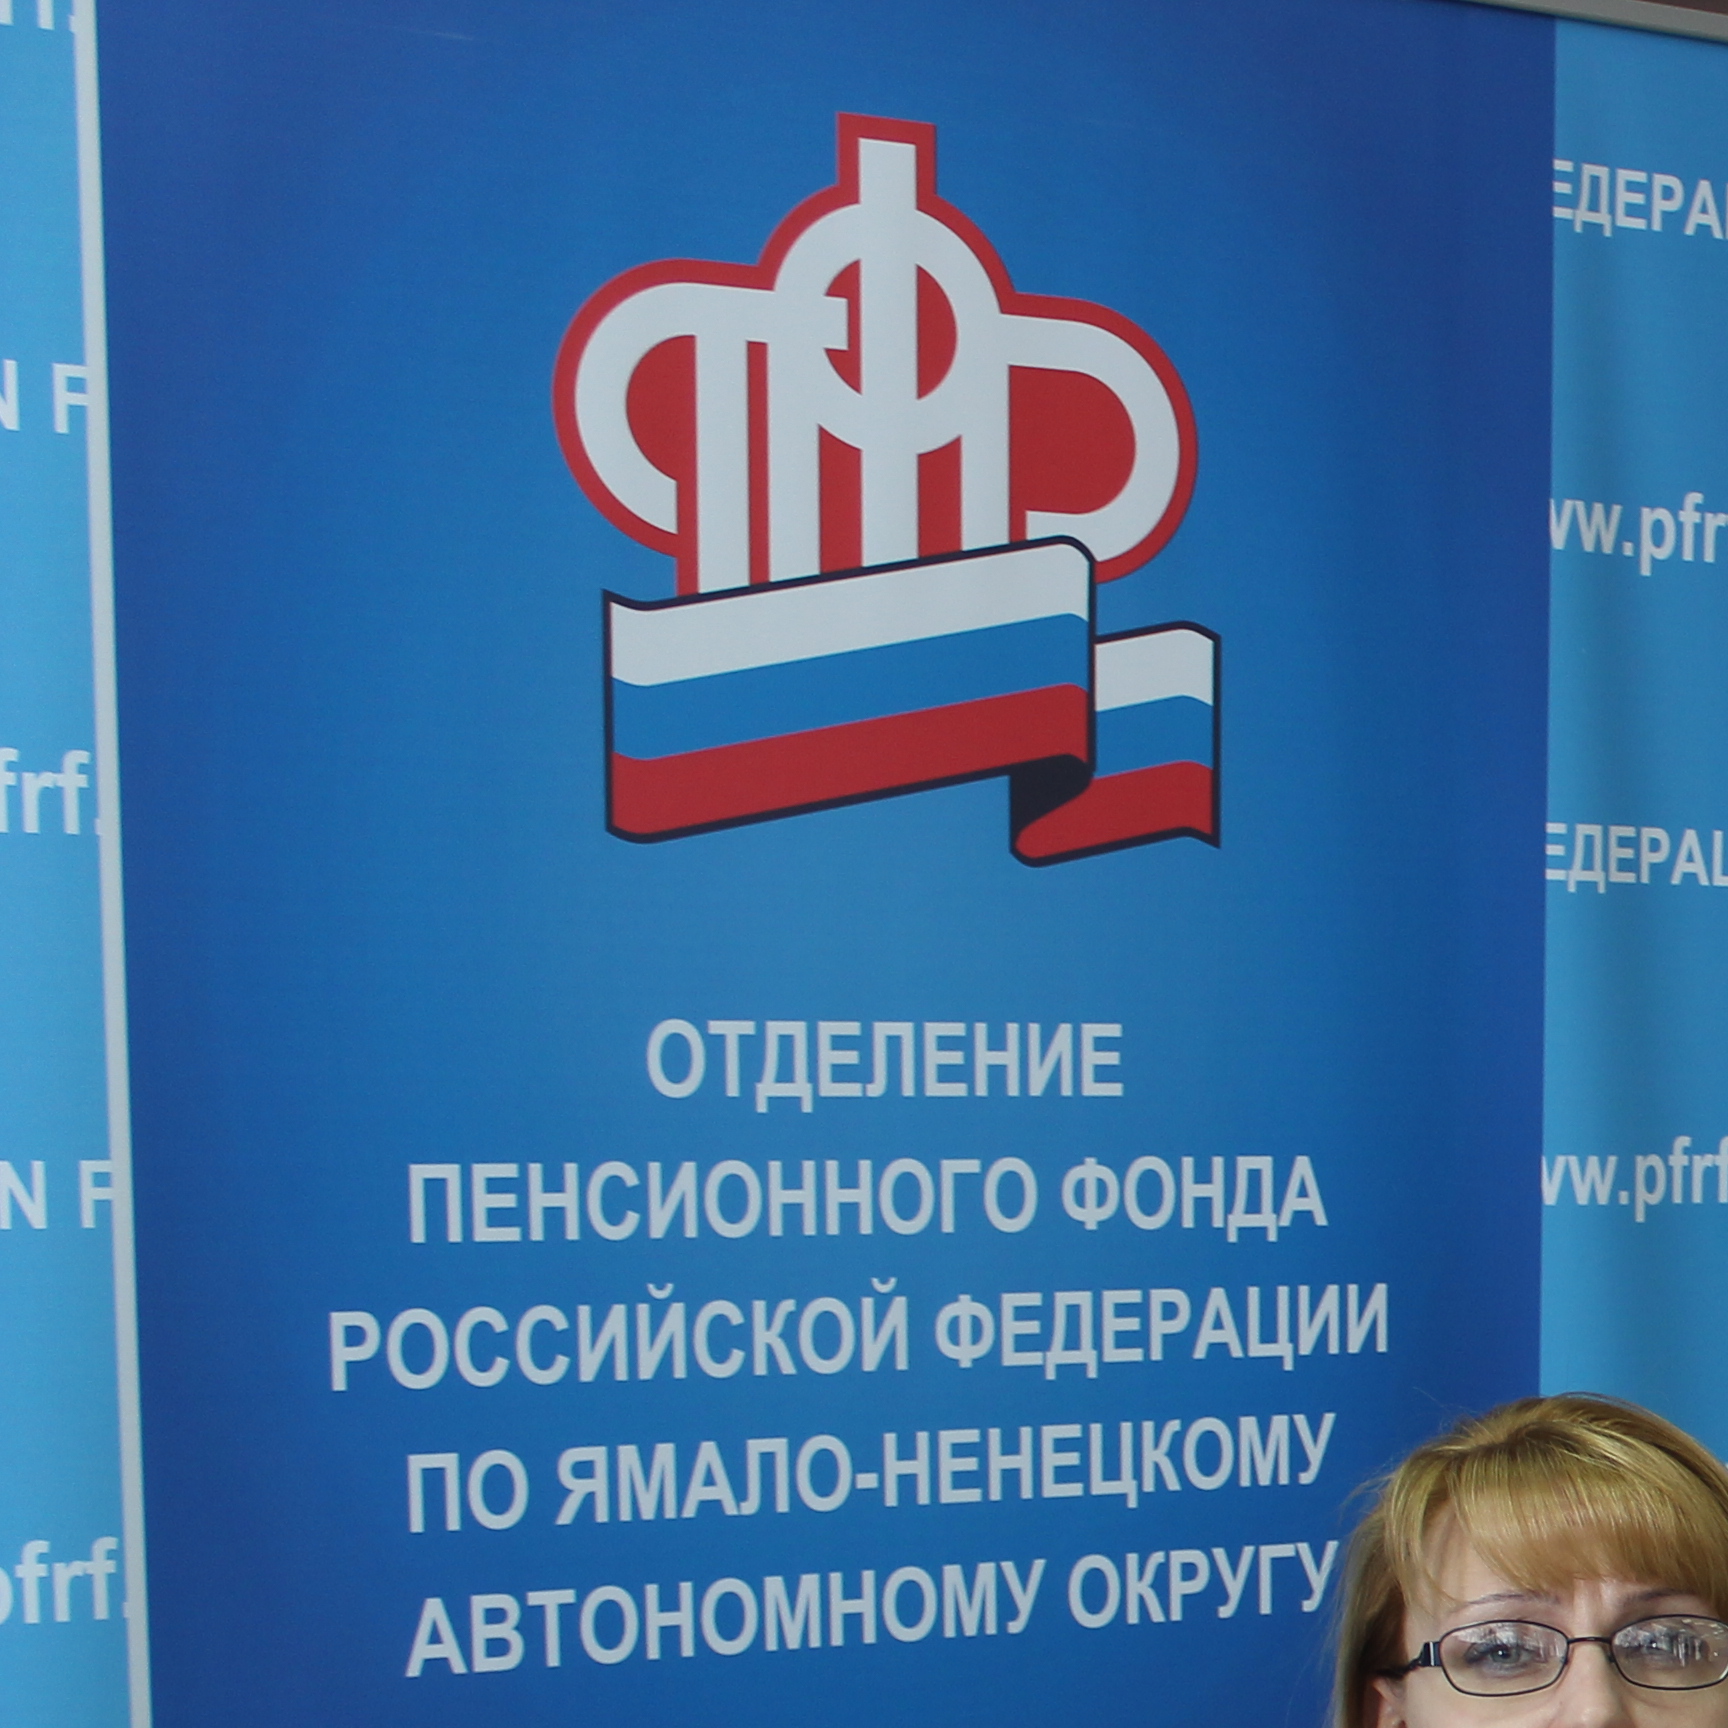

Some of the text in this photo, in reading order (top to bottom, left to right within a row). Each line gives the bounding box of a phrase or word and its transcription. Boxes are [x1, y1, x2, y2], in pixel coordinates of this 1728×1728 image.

[646, 1018, 1125, 1113] ОТДЕЛЕНИЕ
[407, 1155, 1328, 1244] ПЕНСИОННОГО ФОНДА
[328, 1277, 1391, 1392] РОССИЙСКОЙ ФЕДЕРАЦИИ
[407, 1412, 1337, 1533] ПО ЯМАЛО-НЕНЕЦКОМУ
[405, 1540, 1340, 1678] АВТОНОМНОМУ ОКРУГУ
